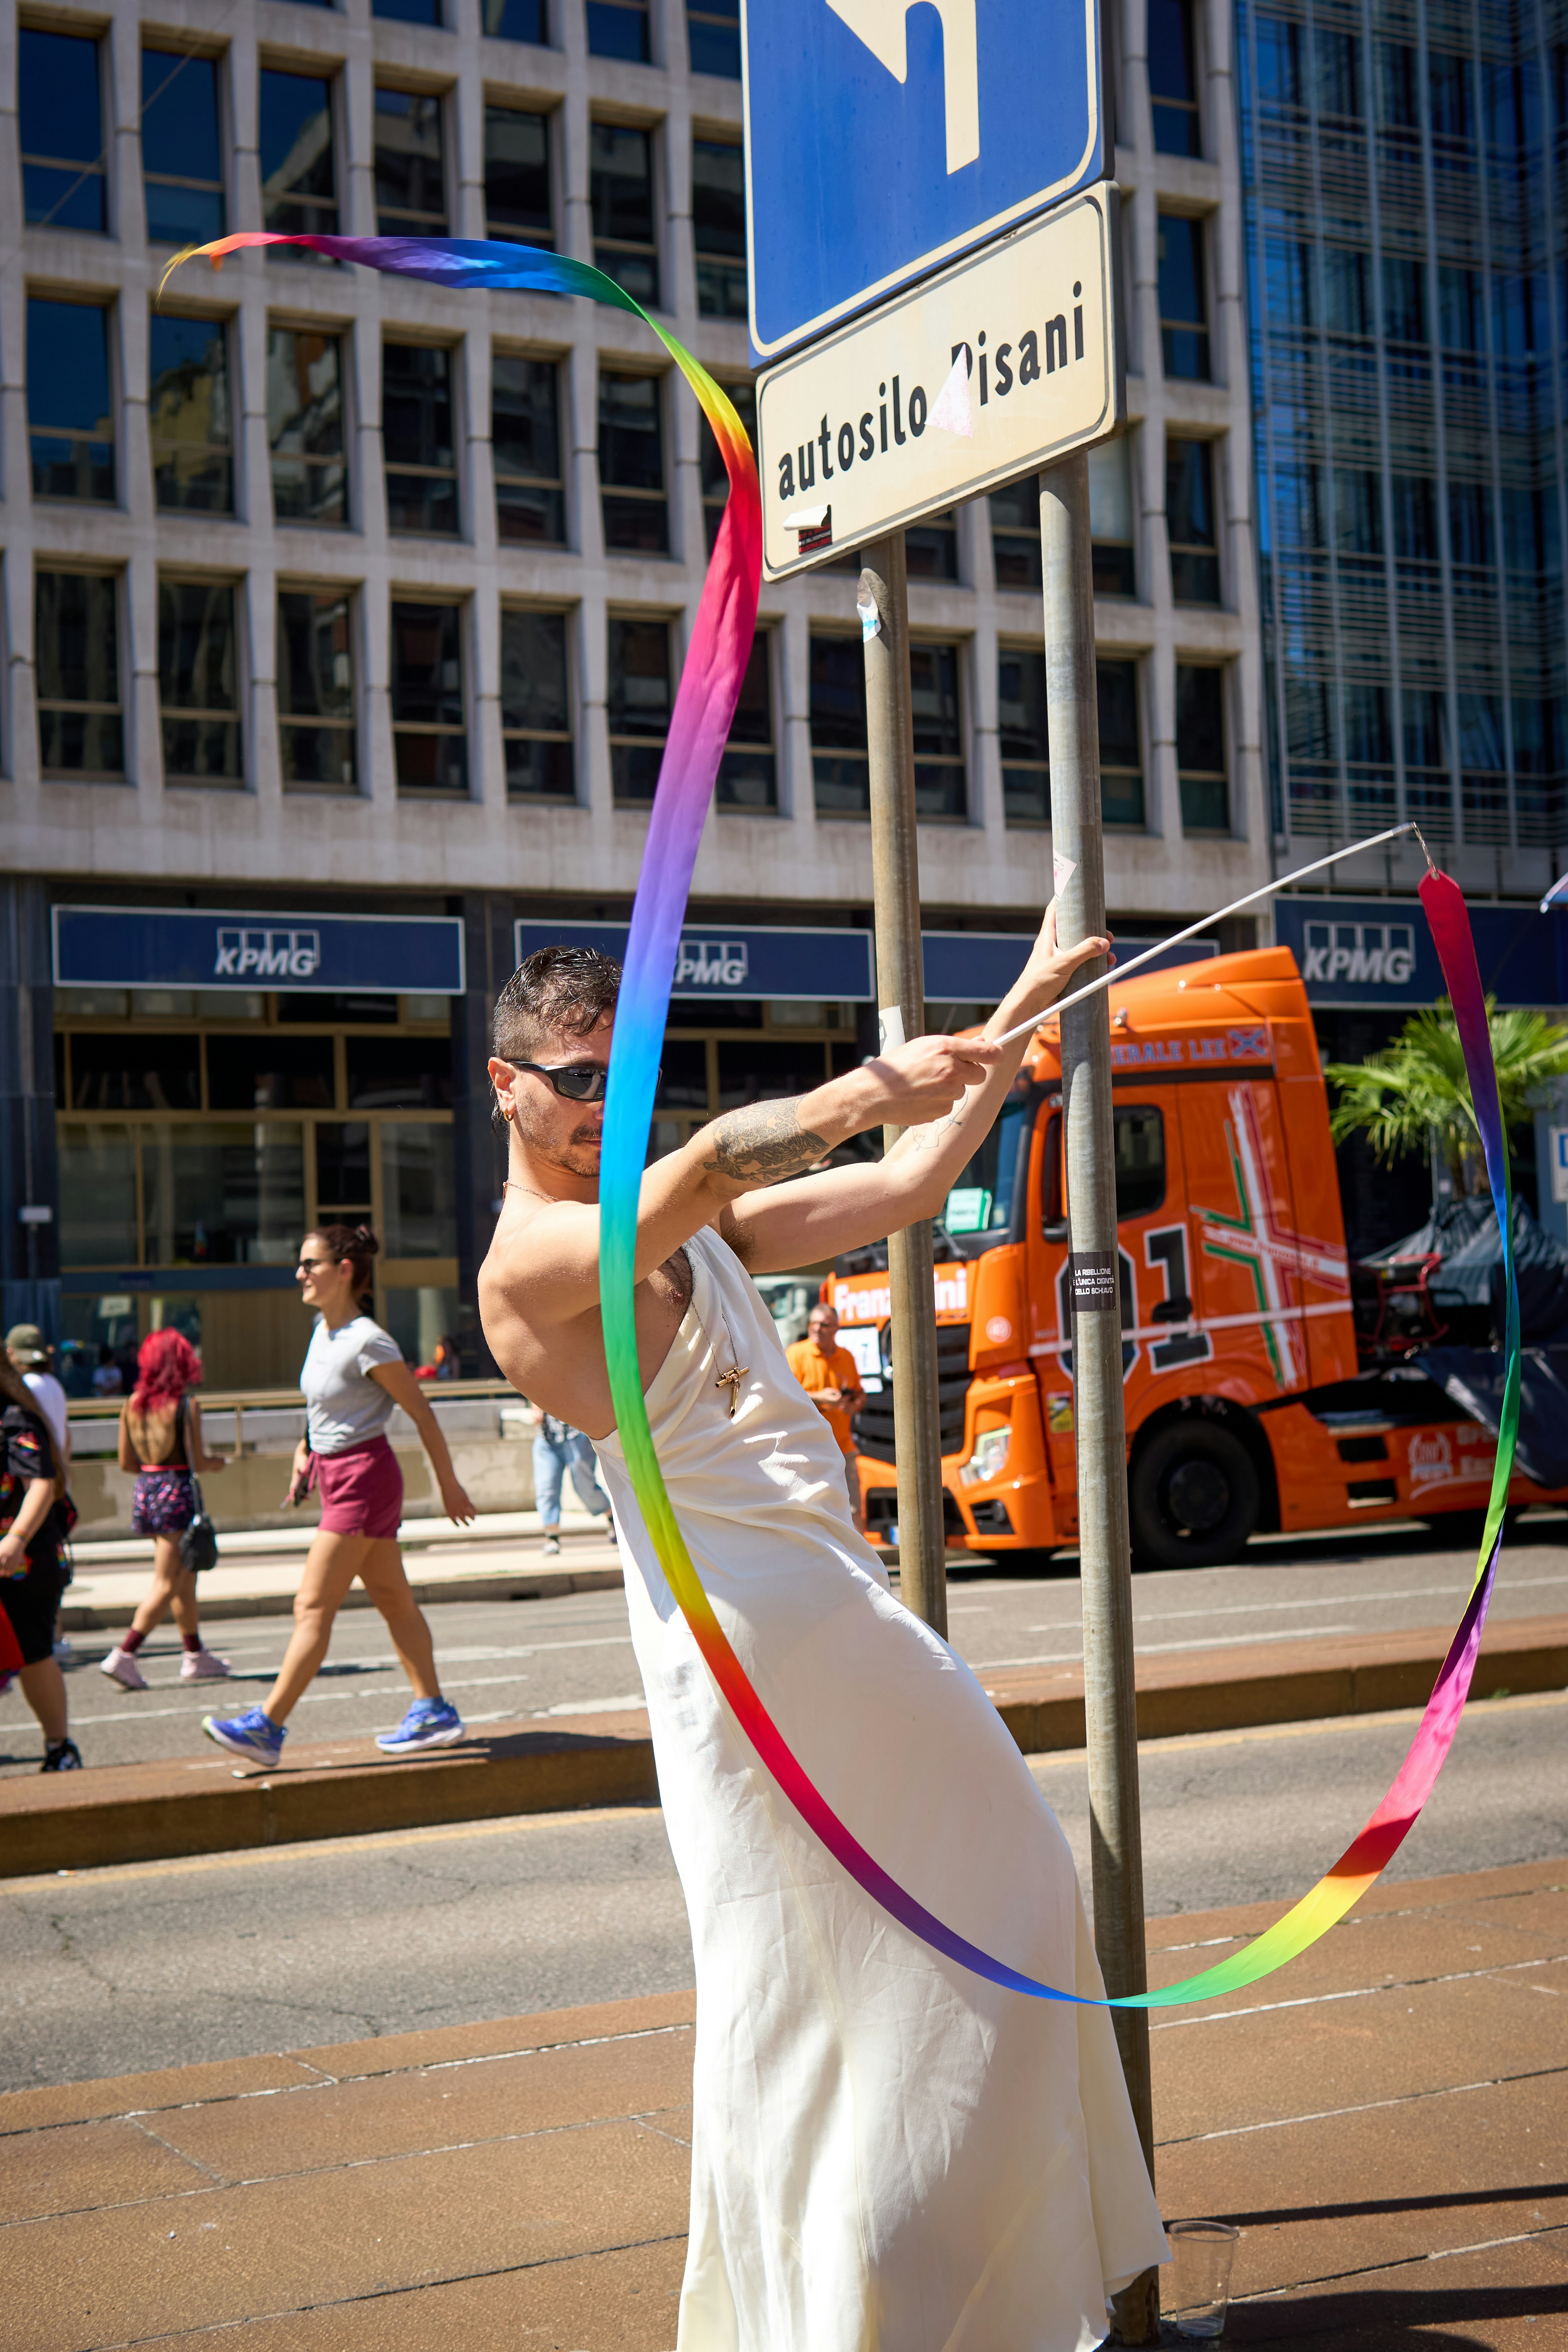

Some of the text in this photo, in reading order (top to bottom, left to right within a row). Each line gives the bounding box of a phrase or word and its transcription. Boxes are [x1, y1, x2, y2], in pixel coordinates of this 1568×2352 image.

[778, 375, 927, 500] autosilo
[214, 947, 315, 976] KPMG
[673, 958, 744, 985] PMG
[1303, 946, 1412, 984] KPMG
[1111, 1038, 1227, 1066] ERALE LEE
[1076, 1277, 1096, 1286] L'UNICA
[1097, 1275, 1114, 1285] DIGNITÀ
